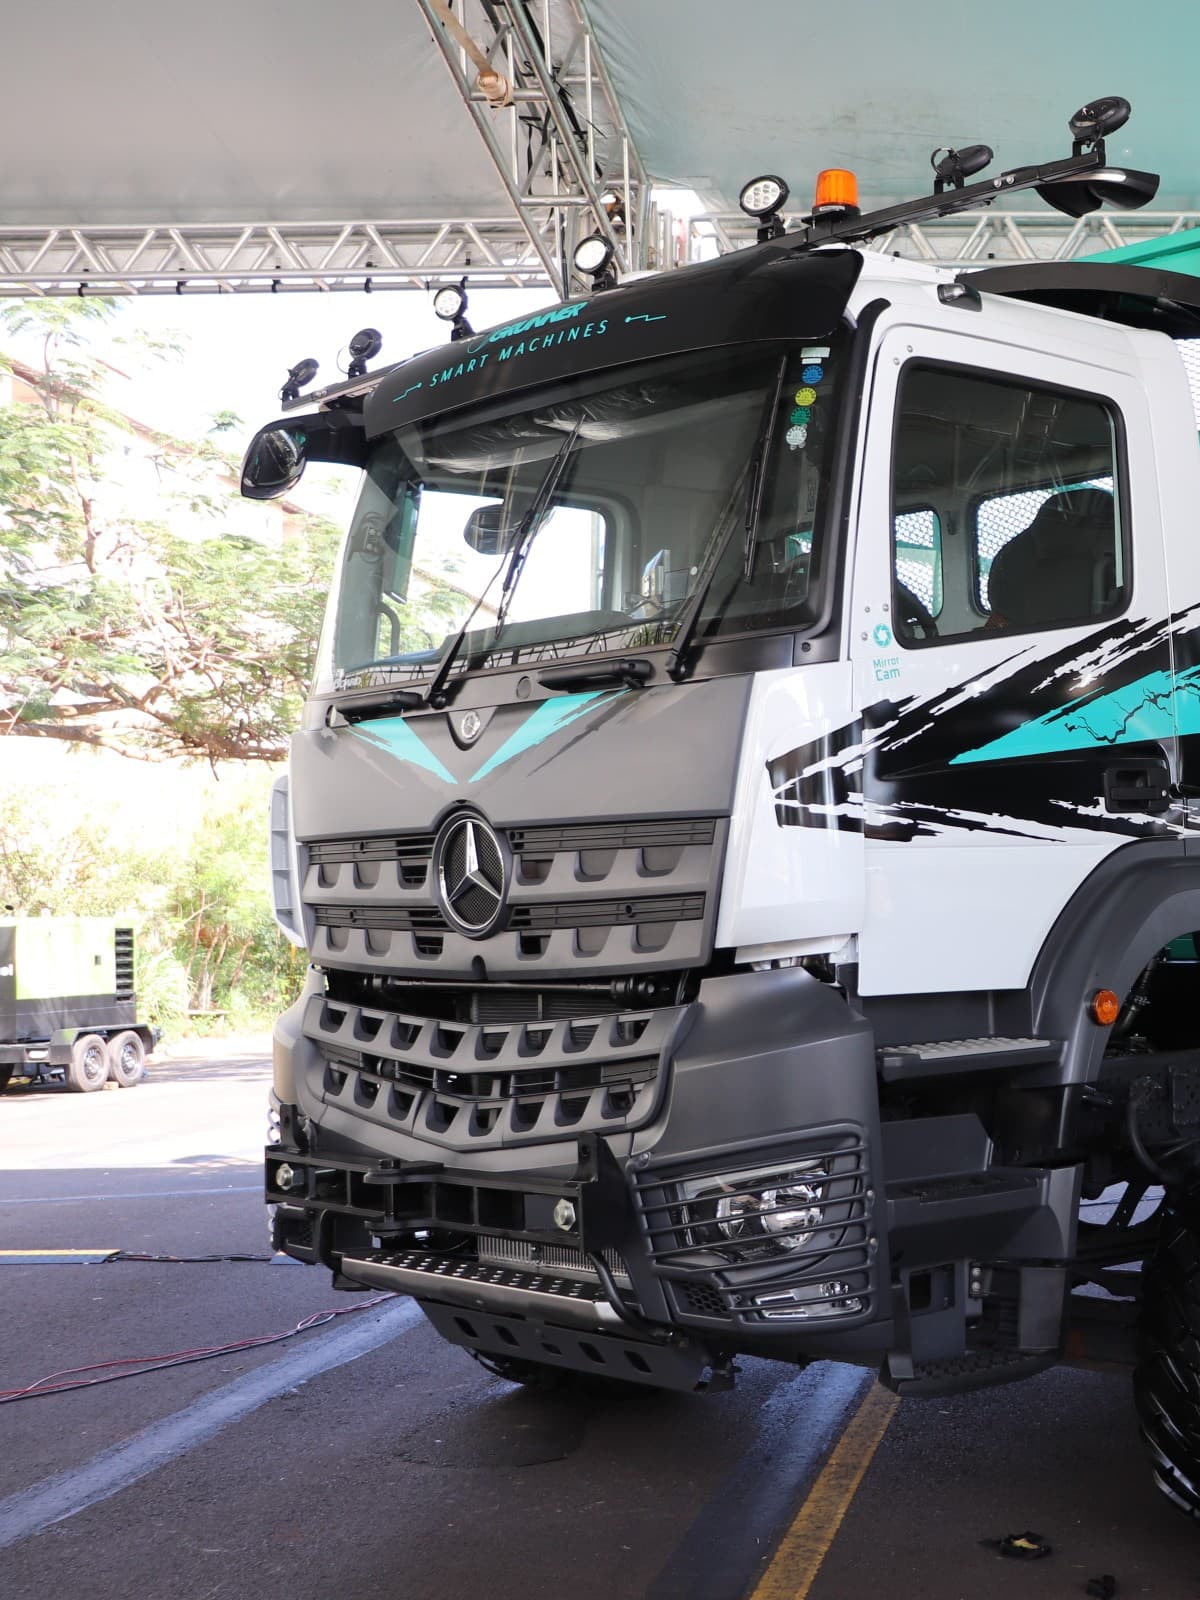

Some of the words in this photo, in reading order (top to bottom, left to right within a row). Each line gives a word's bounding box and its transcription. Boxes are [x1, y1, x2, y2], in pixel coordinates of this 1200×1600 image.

[429, 353, 489, 388] SMART
[498, 319, 610, 362] MACHINES
[873, 656, 901, 669] Mirror
[875, 668, 901, 681] Cam
